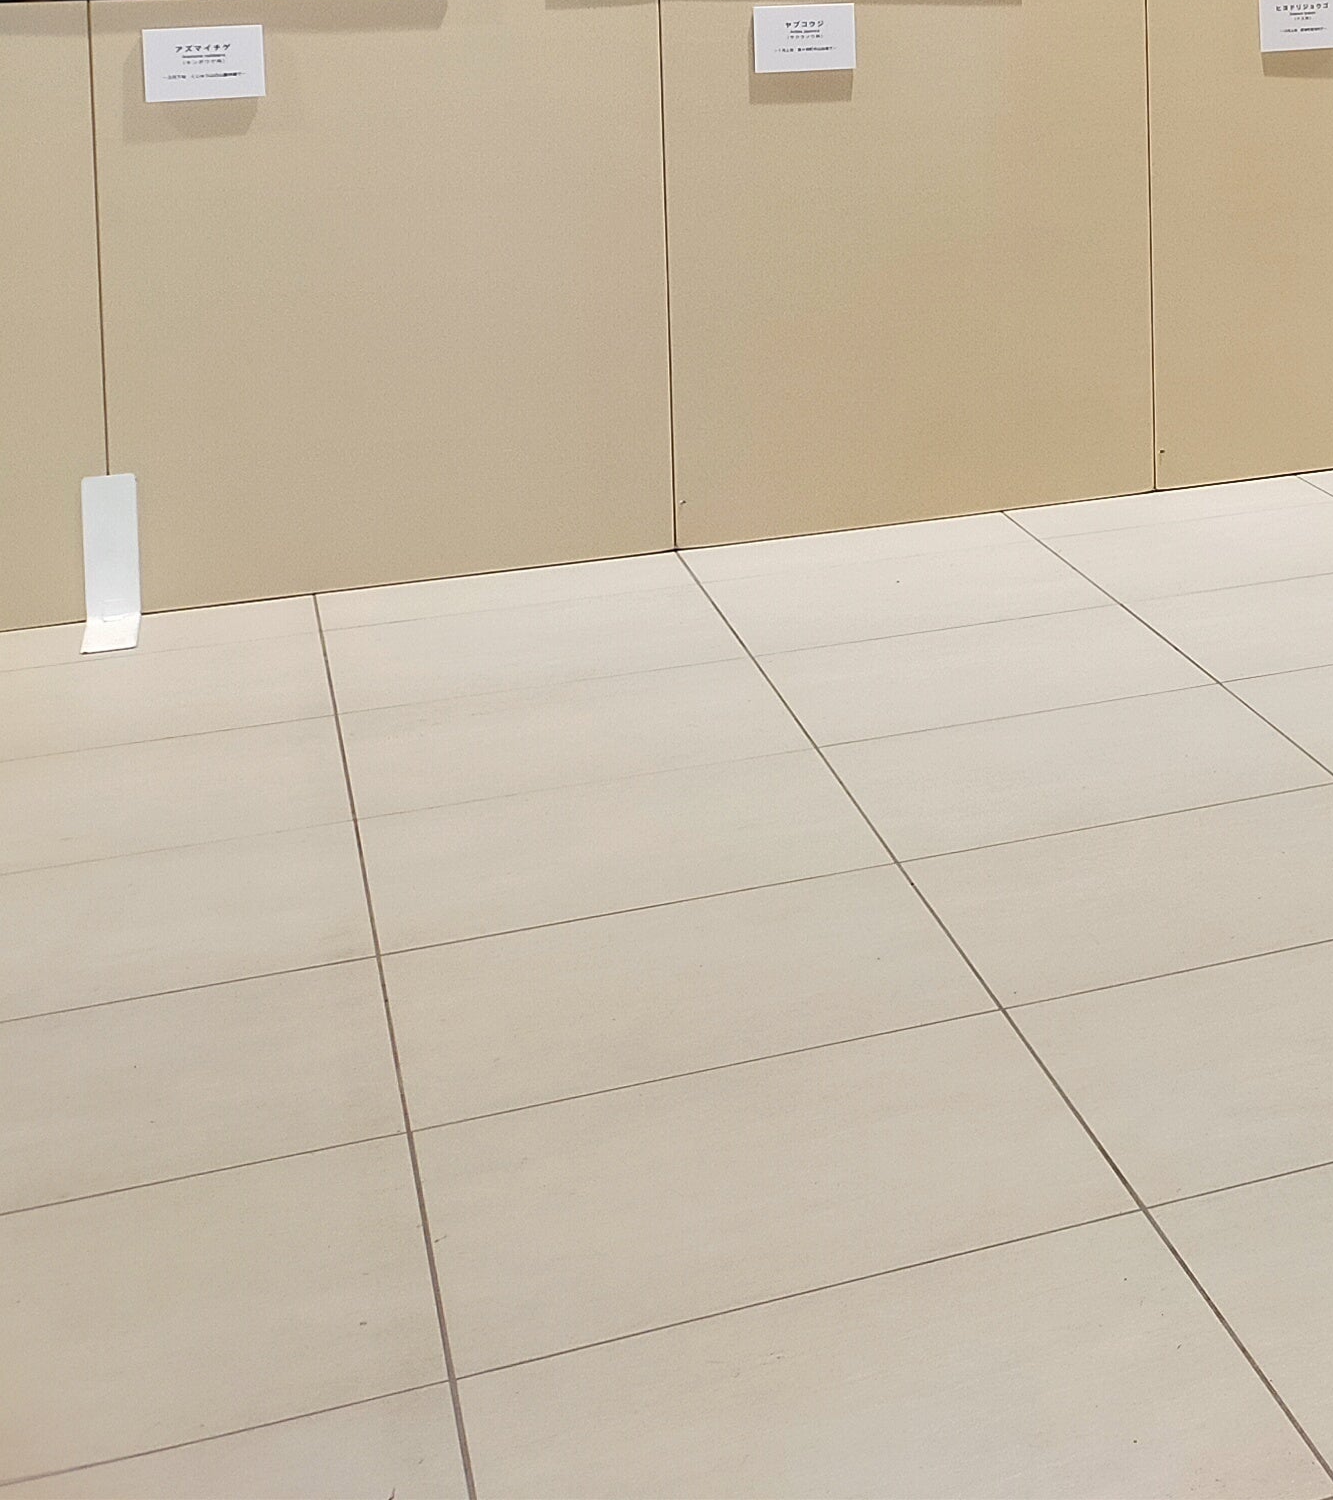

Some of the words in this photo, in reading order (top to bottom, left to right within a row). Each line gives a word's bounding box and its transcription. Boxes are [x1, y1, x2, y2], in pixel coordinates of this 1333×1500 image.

[1275, 2, 1329, 12] ヒヨドリジョウゴ
[785, 20, 824, 28] ヤブコウジ
[175, 43, 231, 53] アズマイチゲ
